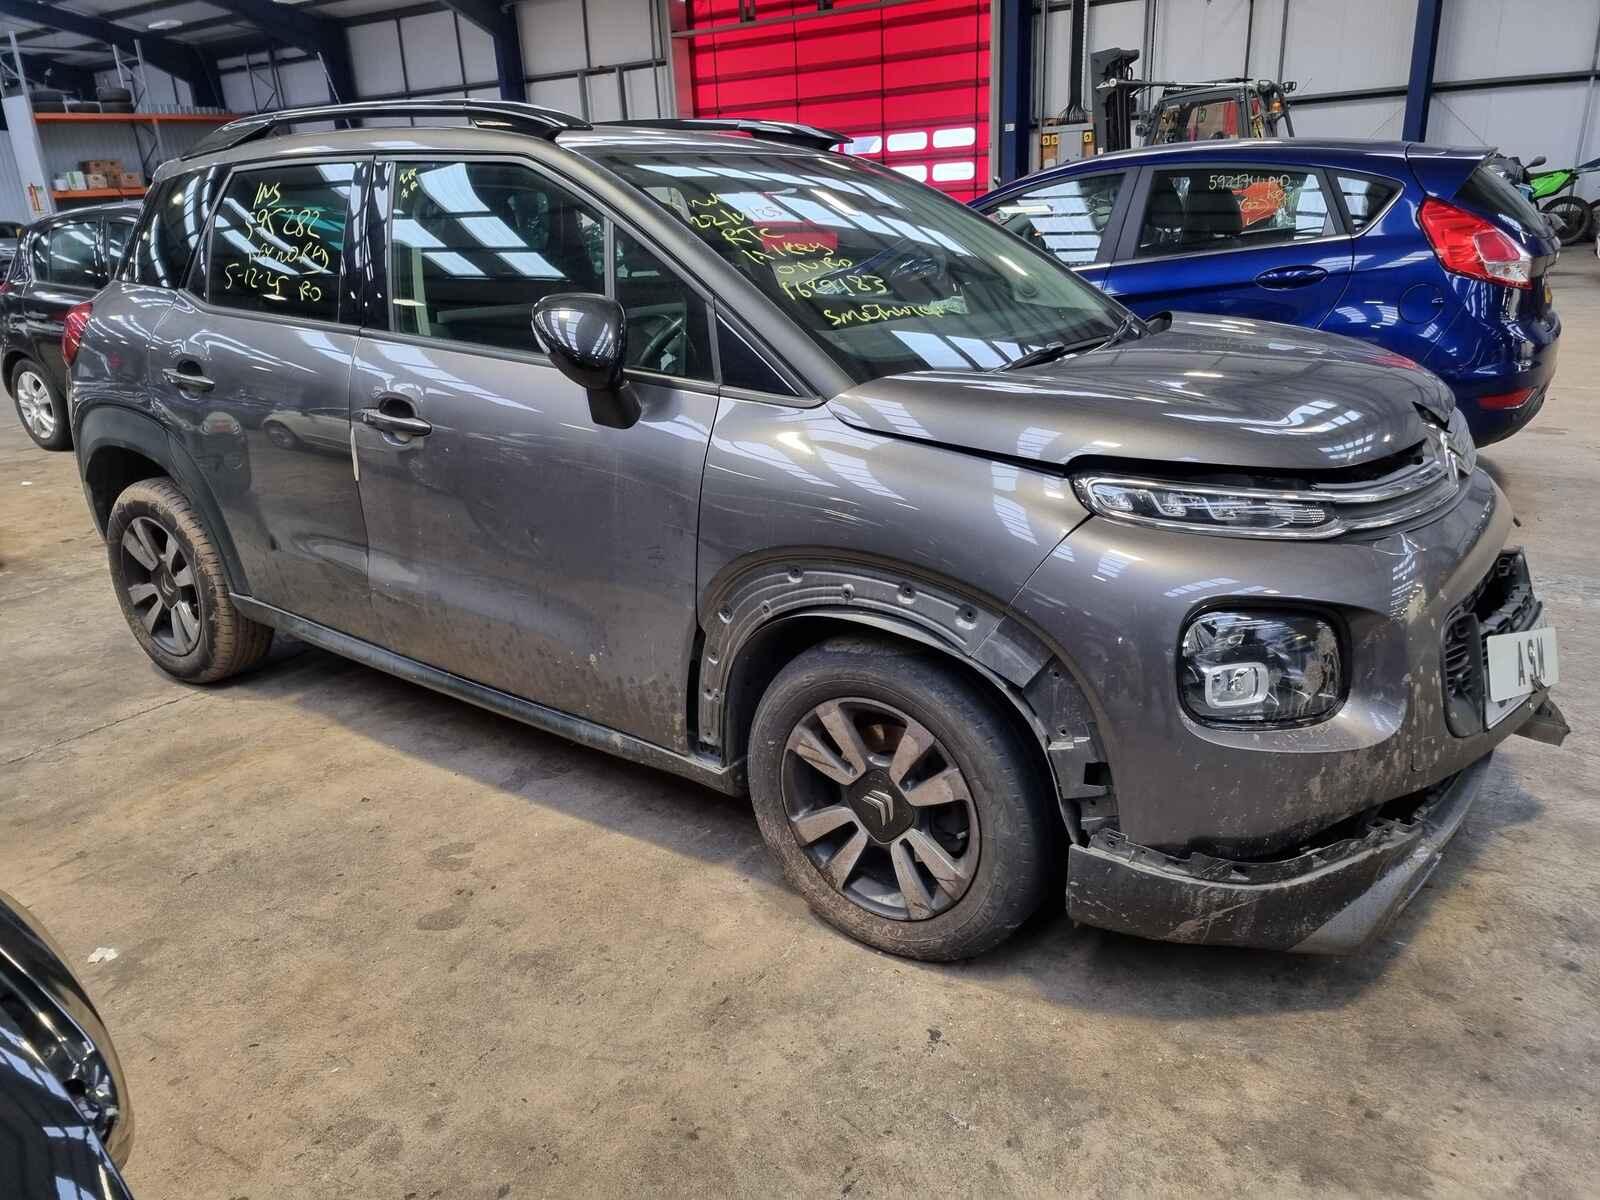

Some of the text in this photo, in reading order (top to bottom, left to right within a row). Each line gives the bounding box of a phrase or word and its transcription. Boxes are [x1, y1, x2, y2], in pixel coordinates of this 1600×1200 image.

[253, 182, 281, 209] INS
[245, 208, 321, 240] 595282
[721, 225, 784, 246] RTC
